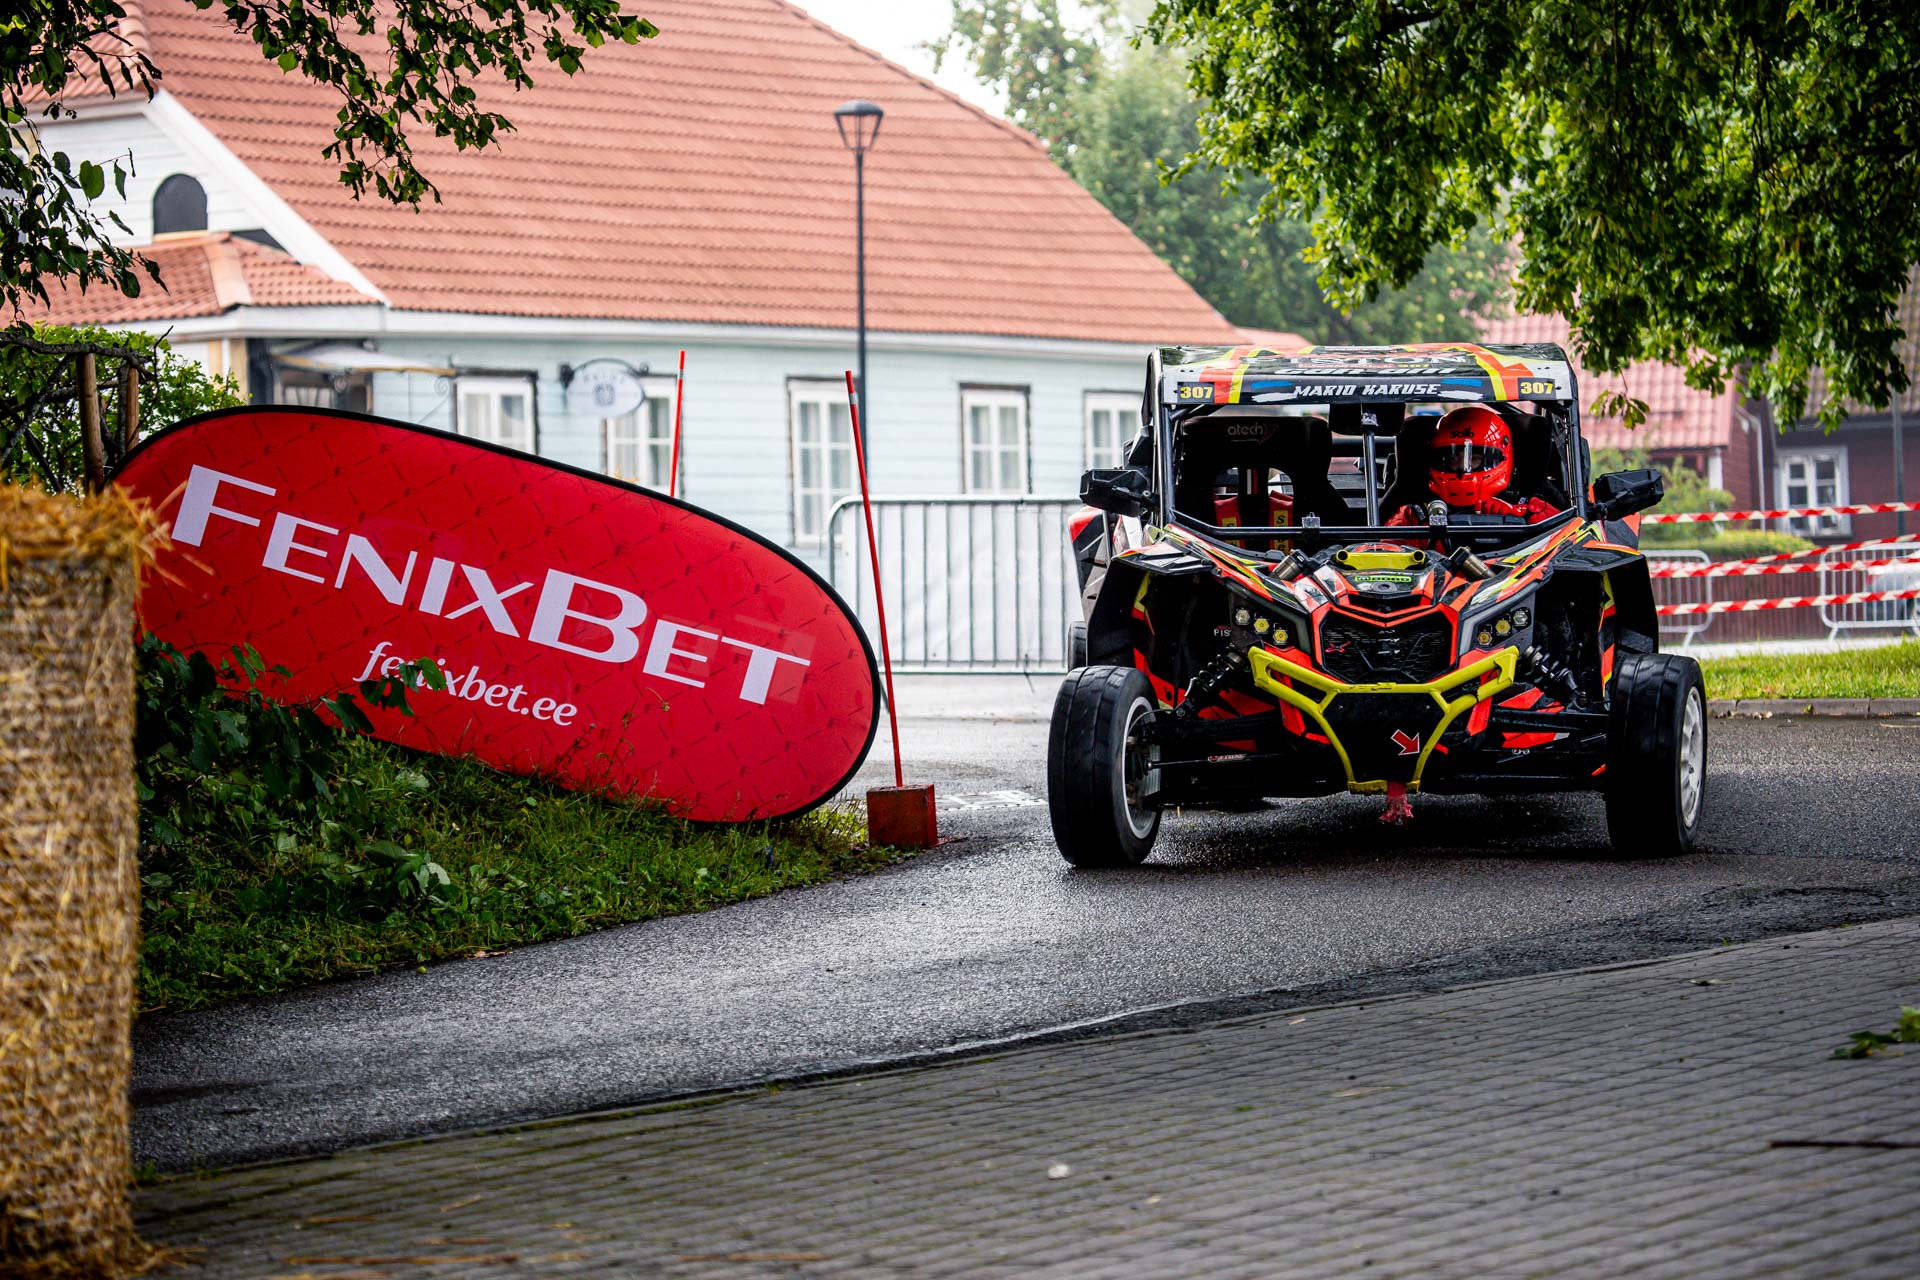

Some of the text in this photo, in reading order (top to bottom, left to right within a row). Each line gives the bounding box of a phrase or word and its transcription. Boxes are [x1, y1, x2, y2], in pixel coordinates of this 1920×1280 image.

[1180, 386, 1213, 399] 307
[1293, 383, 1441, 397] MARIO KARUSE
[1519, 381, 1554, 395] 307
[1227, 421, 1264, 436] atech
[352, 641, 578, 726] fexbet.ee
